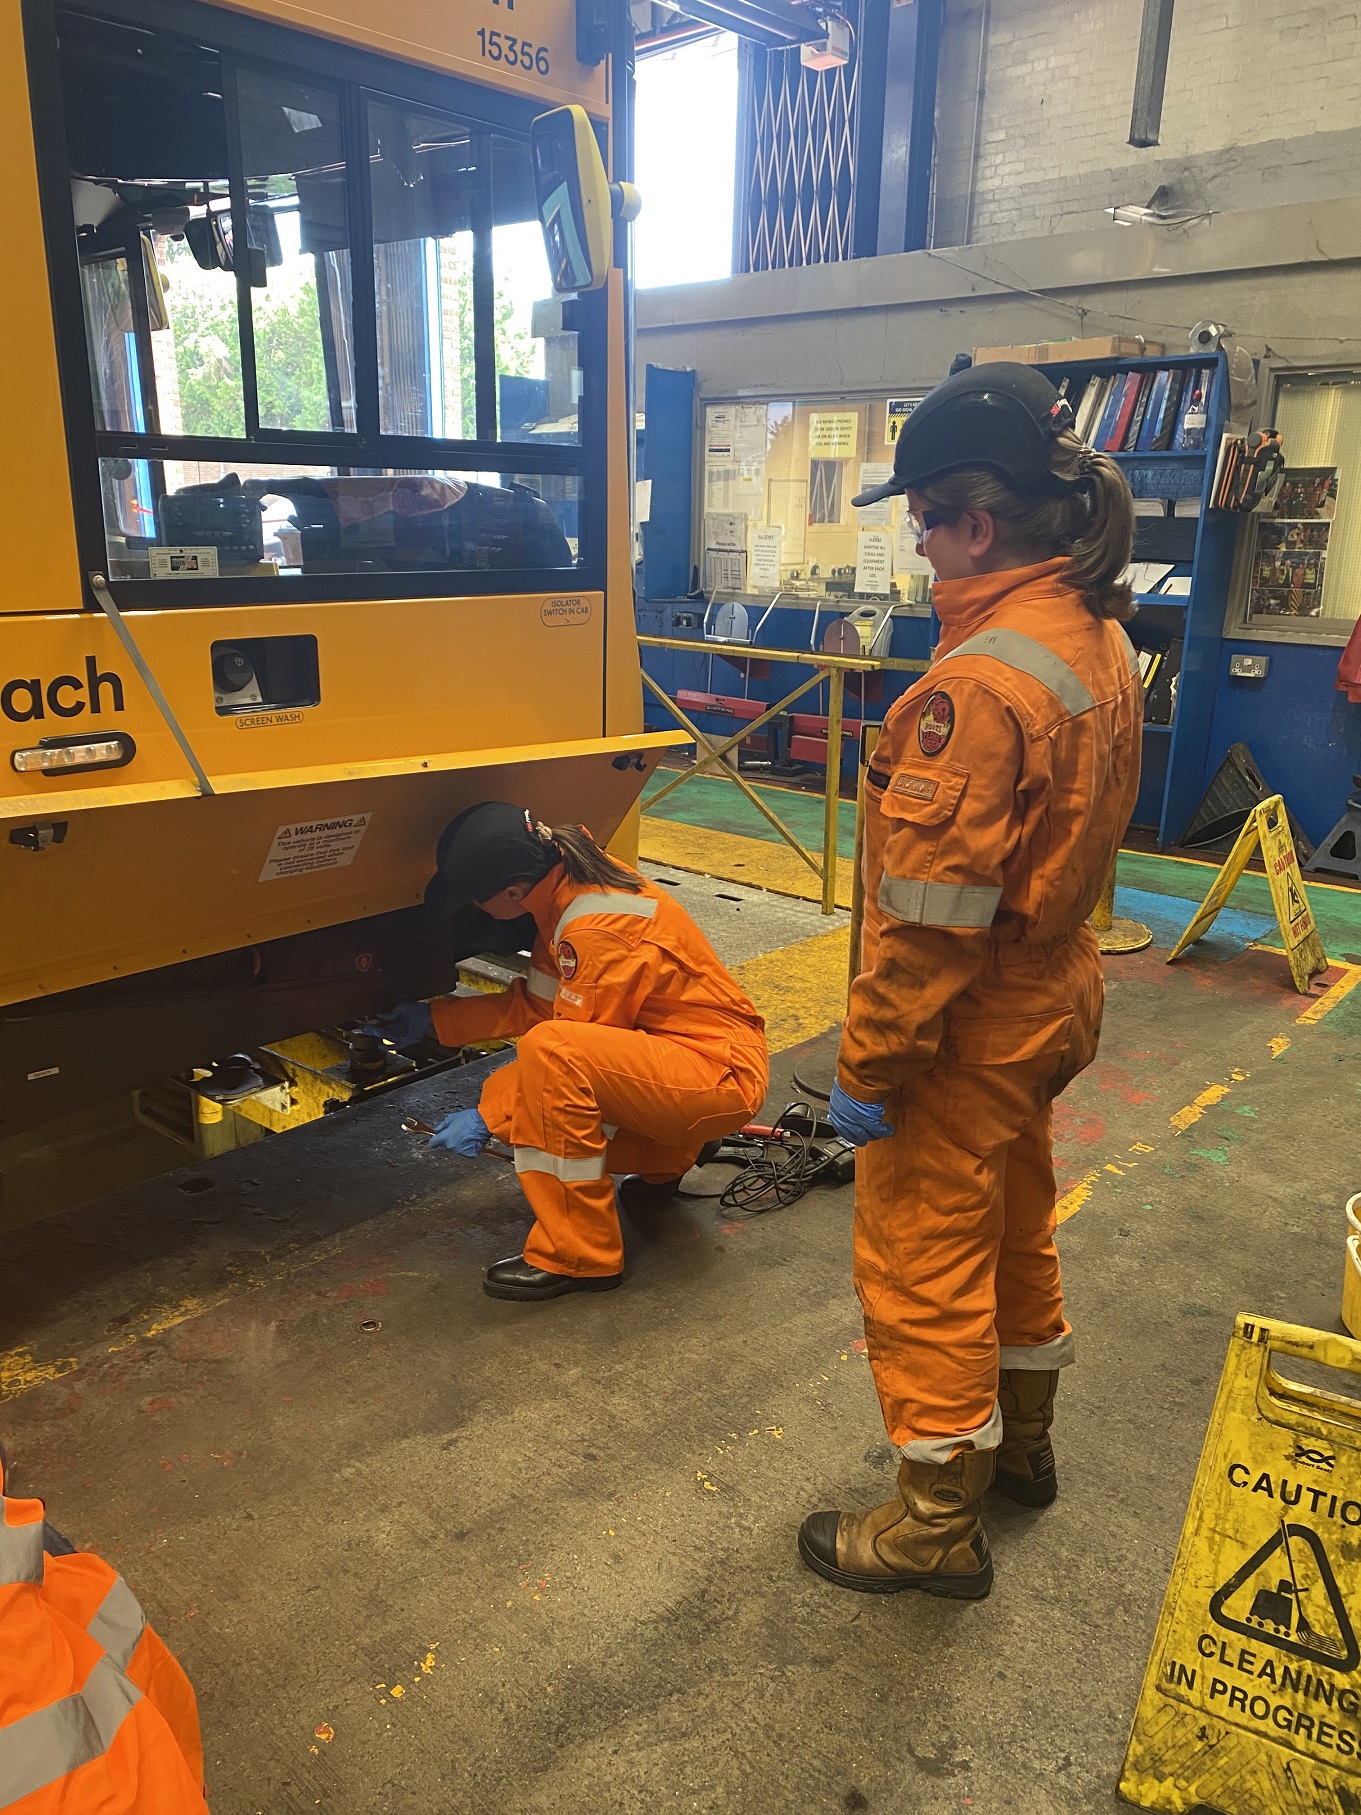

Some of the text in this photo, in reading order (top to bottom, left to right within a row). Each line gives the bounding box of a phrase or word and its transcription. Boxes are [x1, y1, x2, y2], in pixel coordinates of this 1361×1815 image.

[476, 27, 550, 76] 15356
[552, 599, 580, 607] ISOLATOR
[0, 655, 124, 722] ach
[239, 713, 300, 727] SCREEN WASH
[295, 819, 353, 835] WARNING
[282, 843, 307, 851] operate
[322, 836, 351, 844] maximum
[292, 837, 316, 845] vehicle
[324, 831, 352, 840] designed
[295, 855, 326, 864] exceeded
[1228, 1463, 1361, 1526] CAUTIO
[1168, 1660, 1196, 1690] IN
[1198, 1634, 1361, 1716] CLEANING
